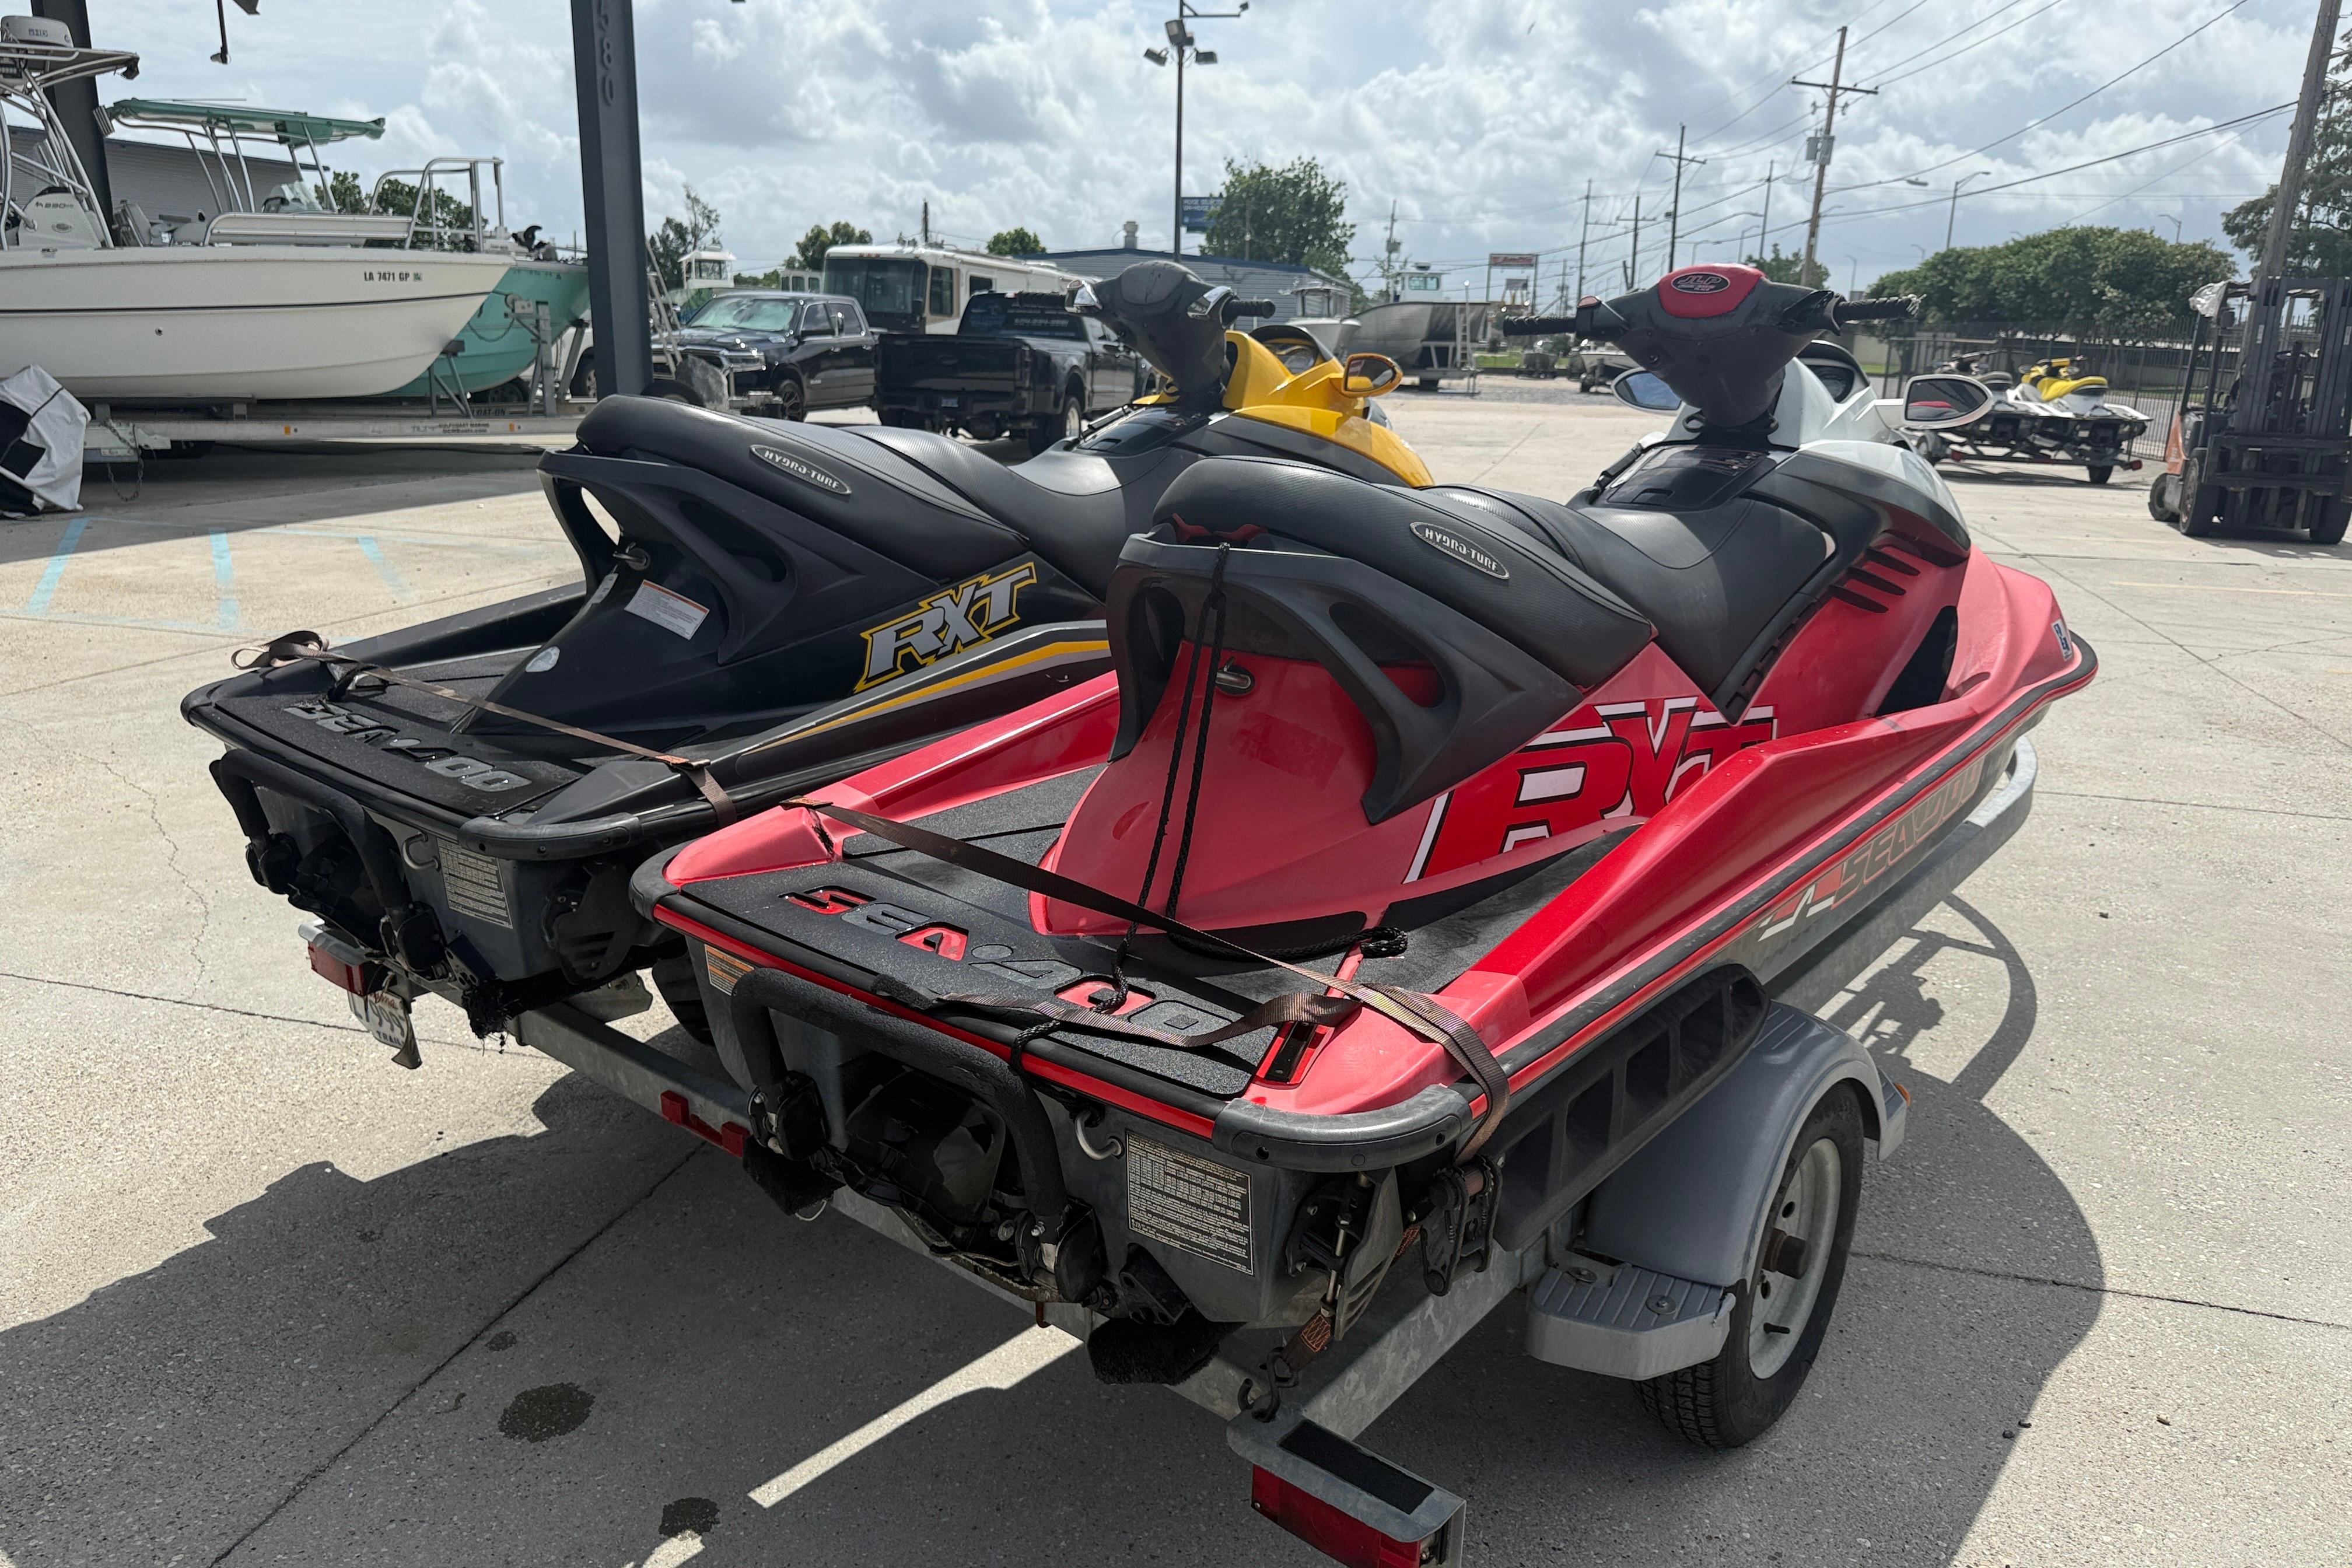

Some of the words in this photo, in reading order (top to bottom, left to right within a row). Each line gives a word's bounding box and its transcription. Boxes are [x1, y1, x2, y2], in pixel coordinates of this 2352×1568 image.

[364, 271, 374, 281] LA
[398, 272, 410, 281] GP
[854, 561, 1037, 694] RXT
[1402, 696, 1777, 884] RXT
